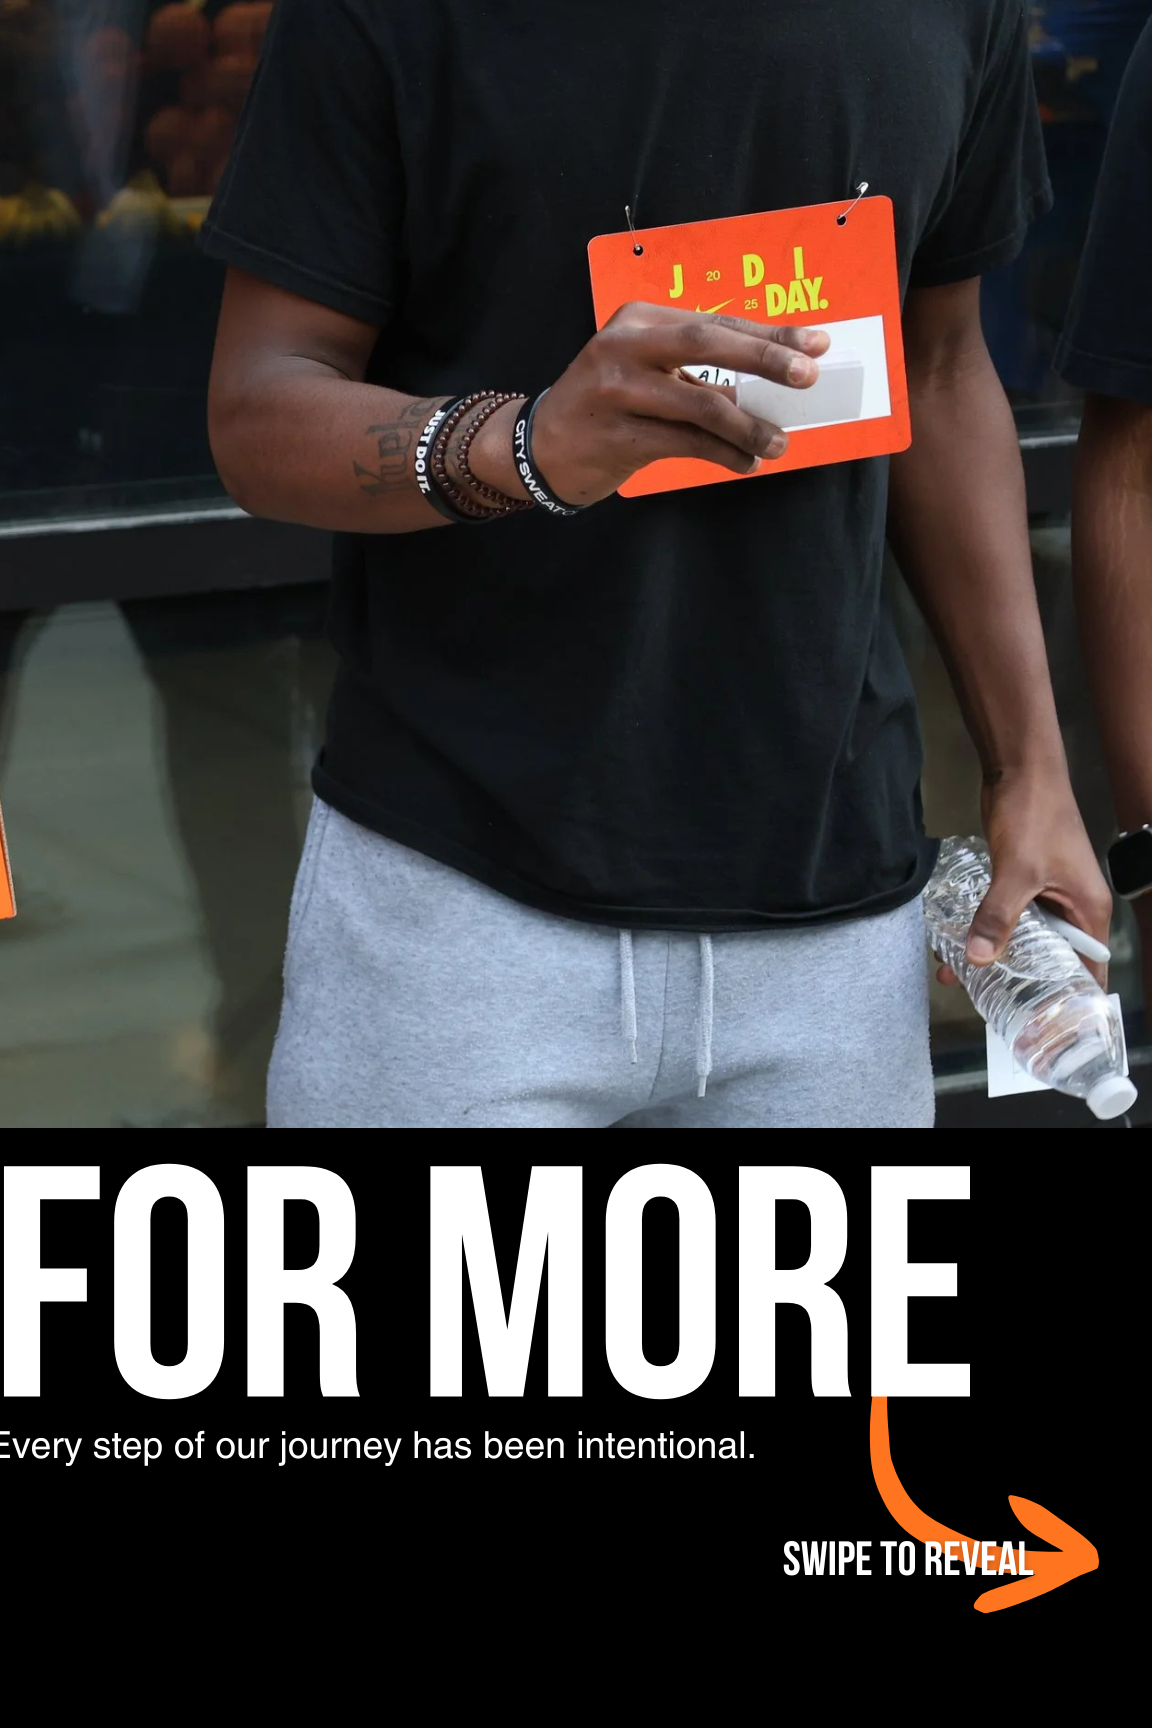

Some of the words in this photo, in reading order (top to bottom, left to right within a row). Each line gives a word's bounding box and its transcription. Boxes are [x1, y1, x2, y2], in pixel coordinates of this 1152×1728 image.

[668, 263, 684, 299] J
[706, 270, 721, 282] 20
[742, 253, 765, 287] D
[793, 246, 804, 280] I
[744, 299, 758, 310] 25
[764, 277, 829, 317] DAY.
[419, 410, 446, 444] JUST
[514, 419, 527, 460] CITY
[415, 446, 428, 473] DO
[416, 475, 431, 494] IT.
[519, 461, 566, 513] SWEAT
